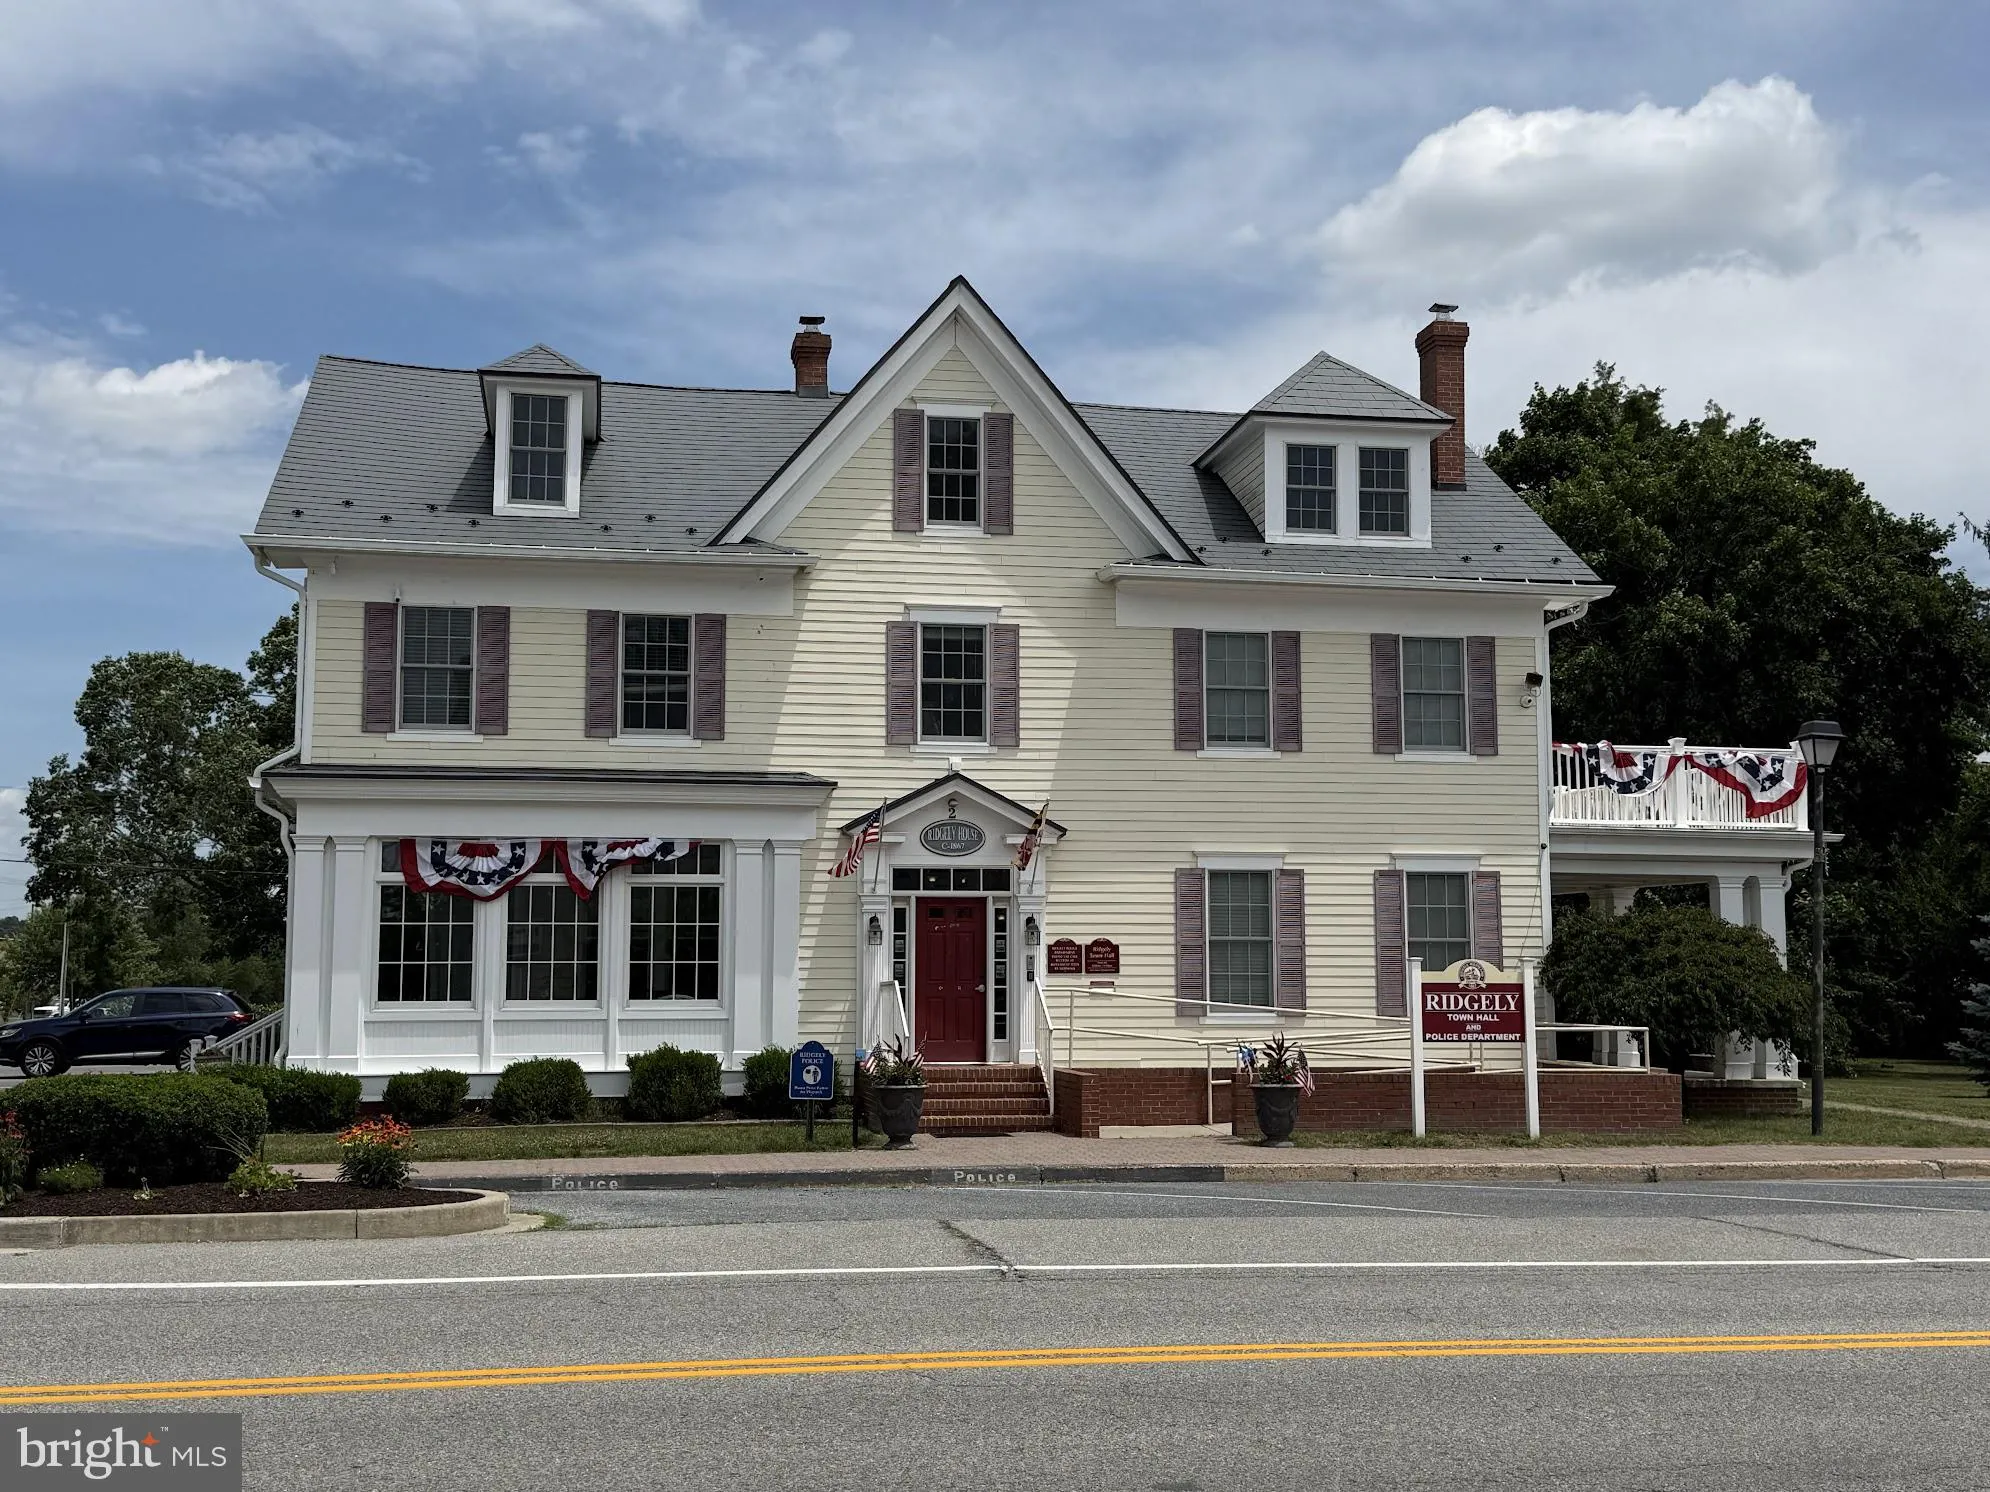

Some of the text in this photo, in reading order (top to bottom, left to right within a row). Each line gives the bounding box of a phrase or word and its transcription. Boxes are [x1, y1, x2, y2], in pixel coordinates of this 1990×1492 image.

[948, 807, 957, 819] 2
[927, 826, 979, 841] RIDGELY HOUSE
[1425, 994, 1520, 1011] RIDGELY
[1447, 1013, 1500, 1022] TOWN HALL
[1425, 1033, 1521, 1041] POLICE DEPARTMENT
